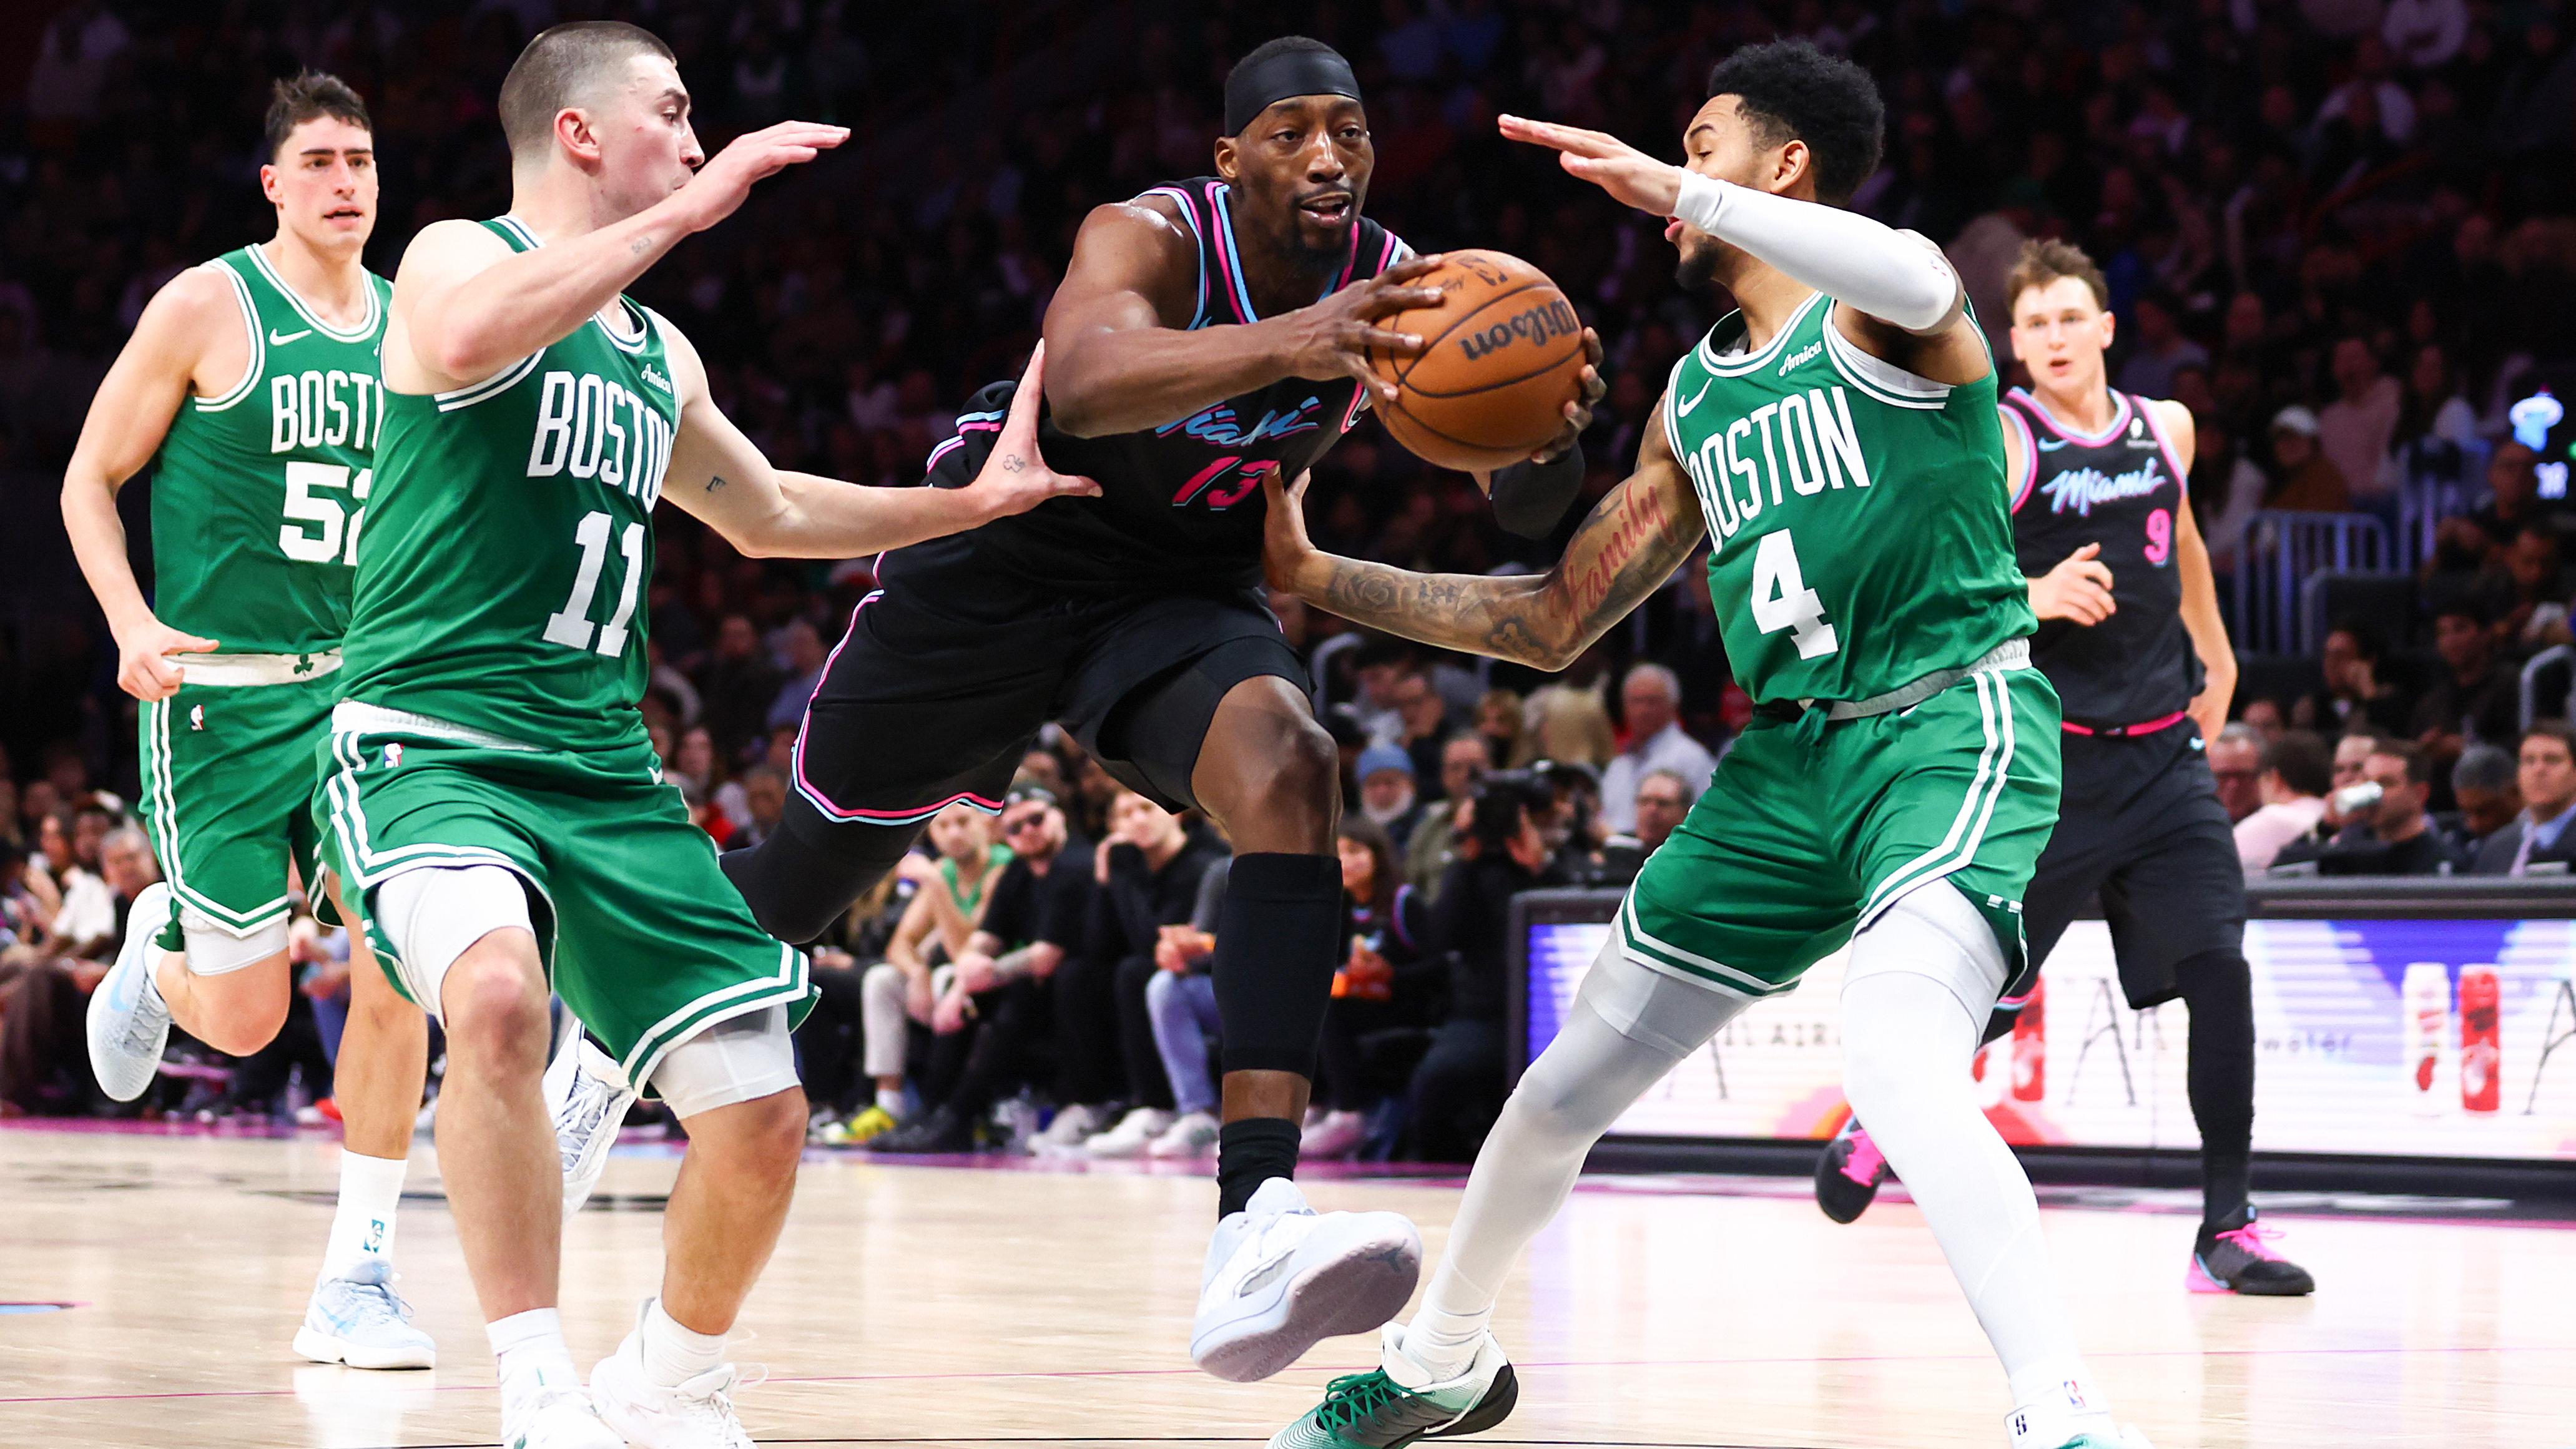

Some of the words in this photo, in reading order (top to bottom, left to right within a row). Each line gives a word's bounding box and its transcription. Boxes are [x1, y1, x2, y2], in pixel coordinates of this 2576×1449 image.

[1458, 298, 1580, 361] Wilson
[1778, 340, 1823, 377] Amica
[641, 363, 672, 395] Amica
[1172, 455, 1281, 511] 13
[1688, 385, 1871, 556] BOSTON
[2040, 456, 2167, 517] Miami
[1548, 481, 1678, 638] Family
[2143, 508, 2173, 568] 9
[541, 509, 646, 659] 11
[1750, 528, 1839, 661] 4
